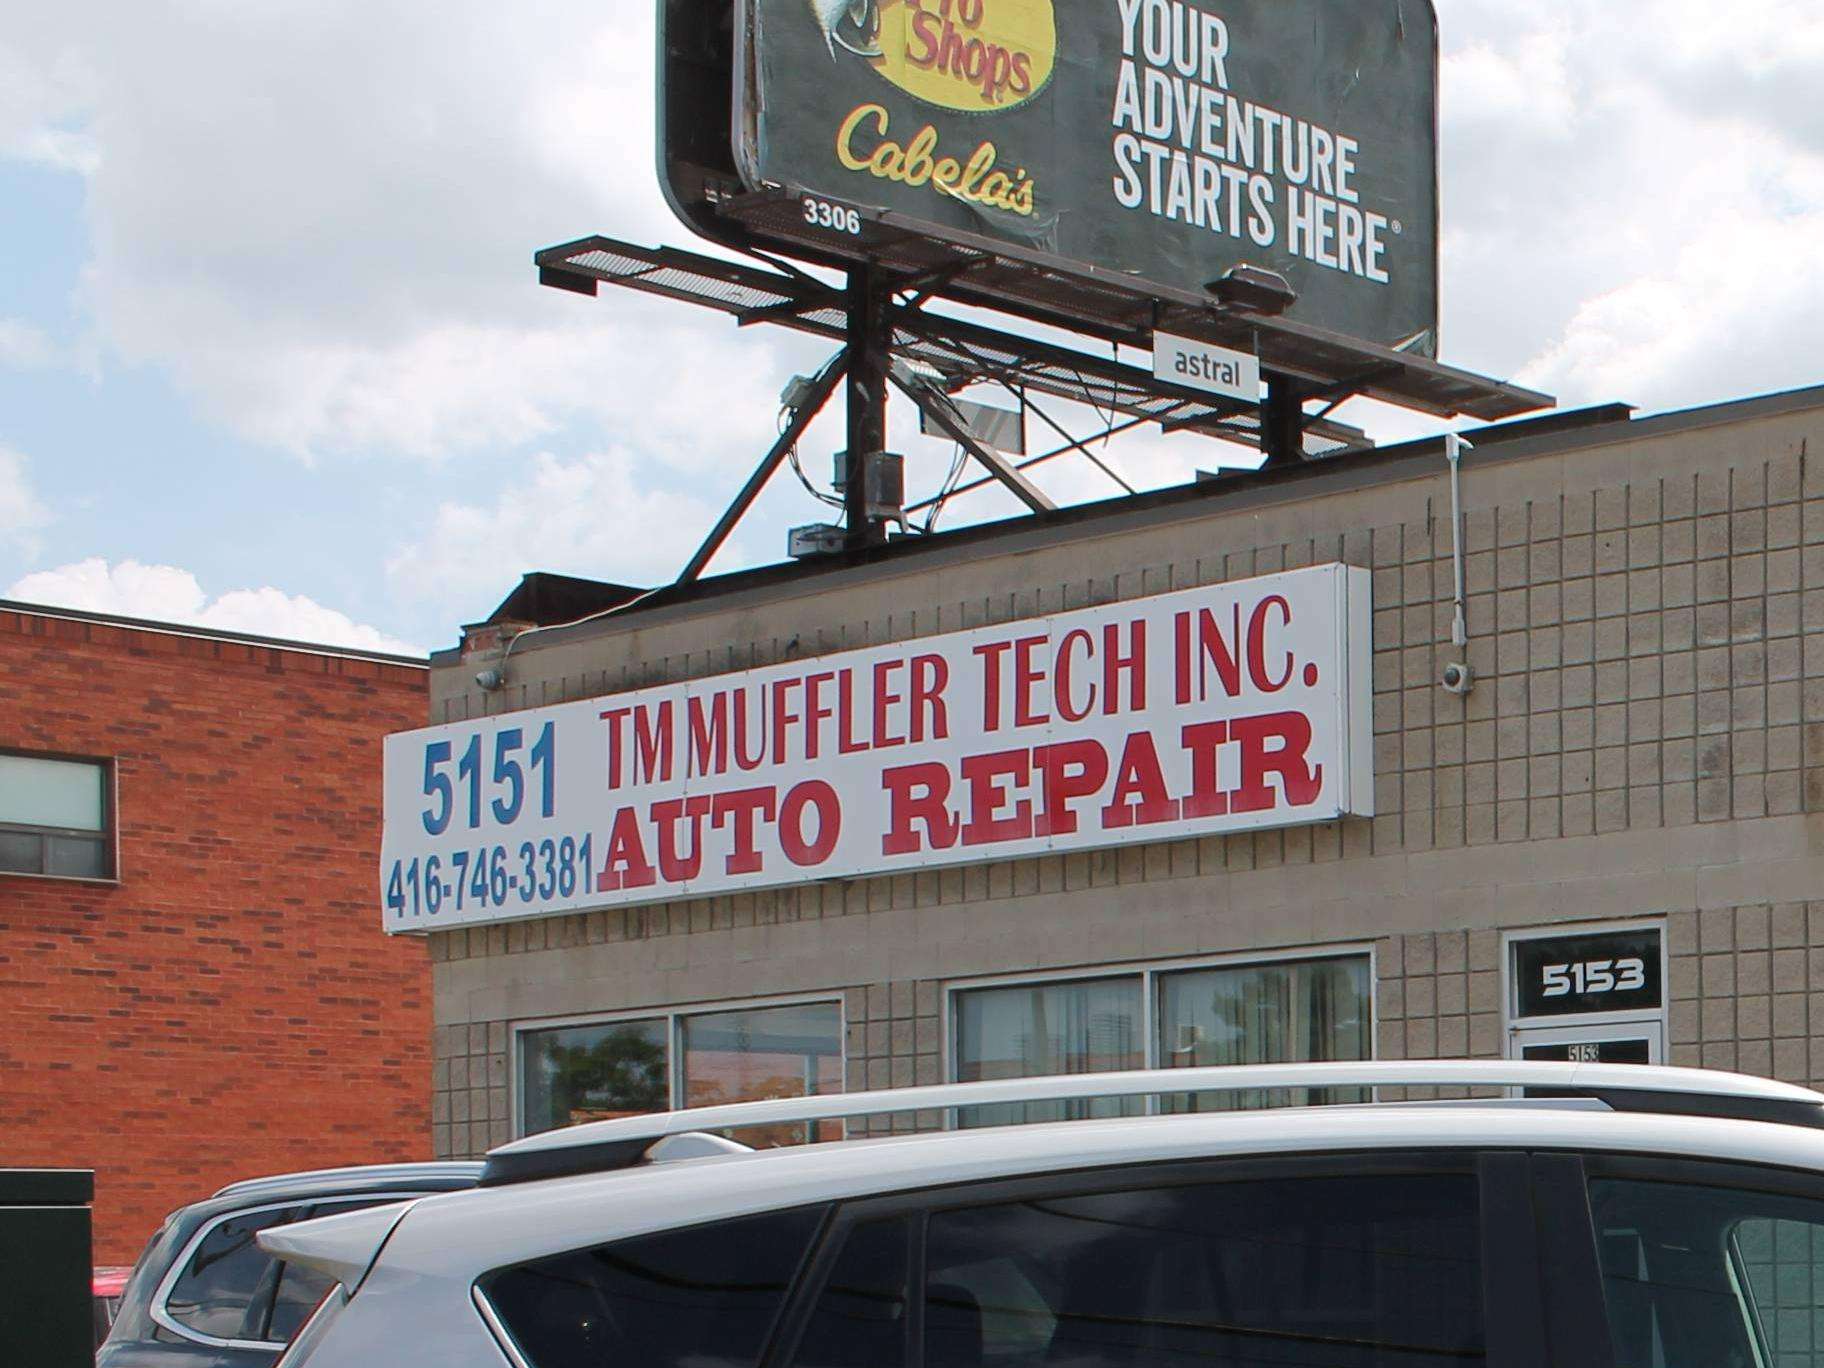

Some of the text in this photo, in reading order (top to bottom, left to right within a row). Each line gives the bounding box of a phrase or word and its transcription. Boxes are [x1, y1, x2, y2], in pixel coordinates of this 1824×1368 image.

[905, 10, 1032, 104] Shops
[1117, 0, 1229, 89] YOUR
[837, 104, 1034, 216] Cabela's
[1112, 59, 1359, 203] ADVENTURE
[804, 199, 861, 235] 3306
[1113, 133, 1275, 247] STARTS
[1175, 351, 1240, 386] astral
[602, 594, 1319, 789] TM MUFFLER TECH INC.
[421, 718, 556, 837] 5151
[597, 711, 1323, 891] AUTO REPAIR
[386, 832, 594, 919] 416-746-3381
[1542, 958, 1646, 997] 5153
